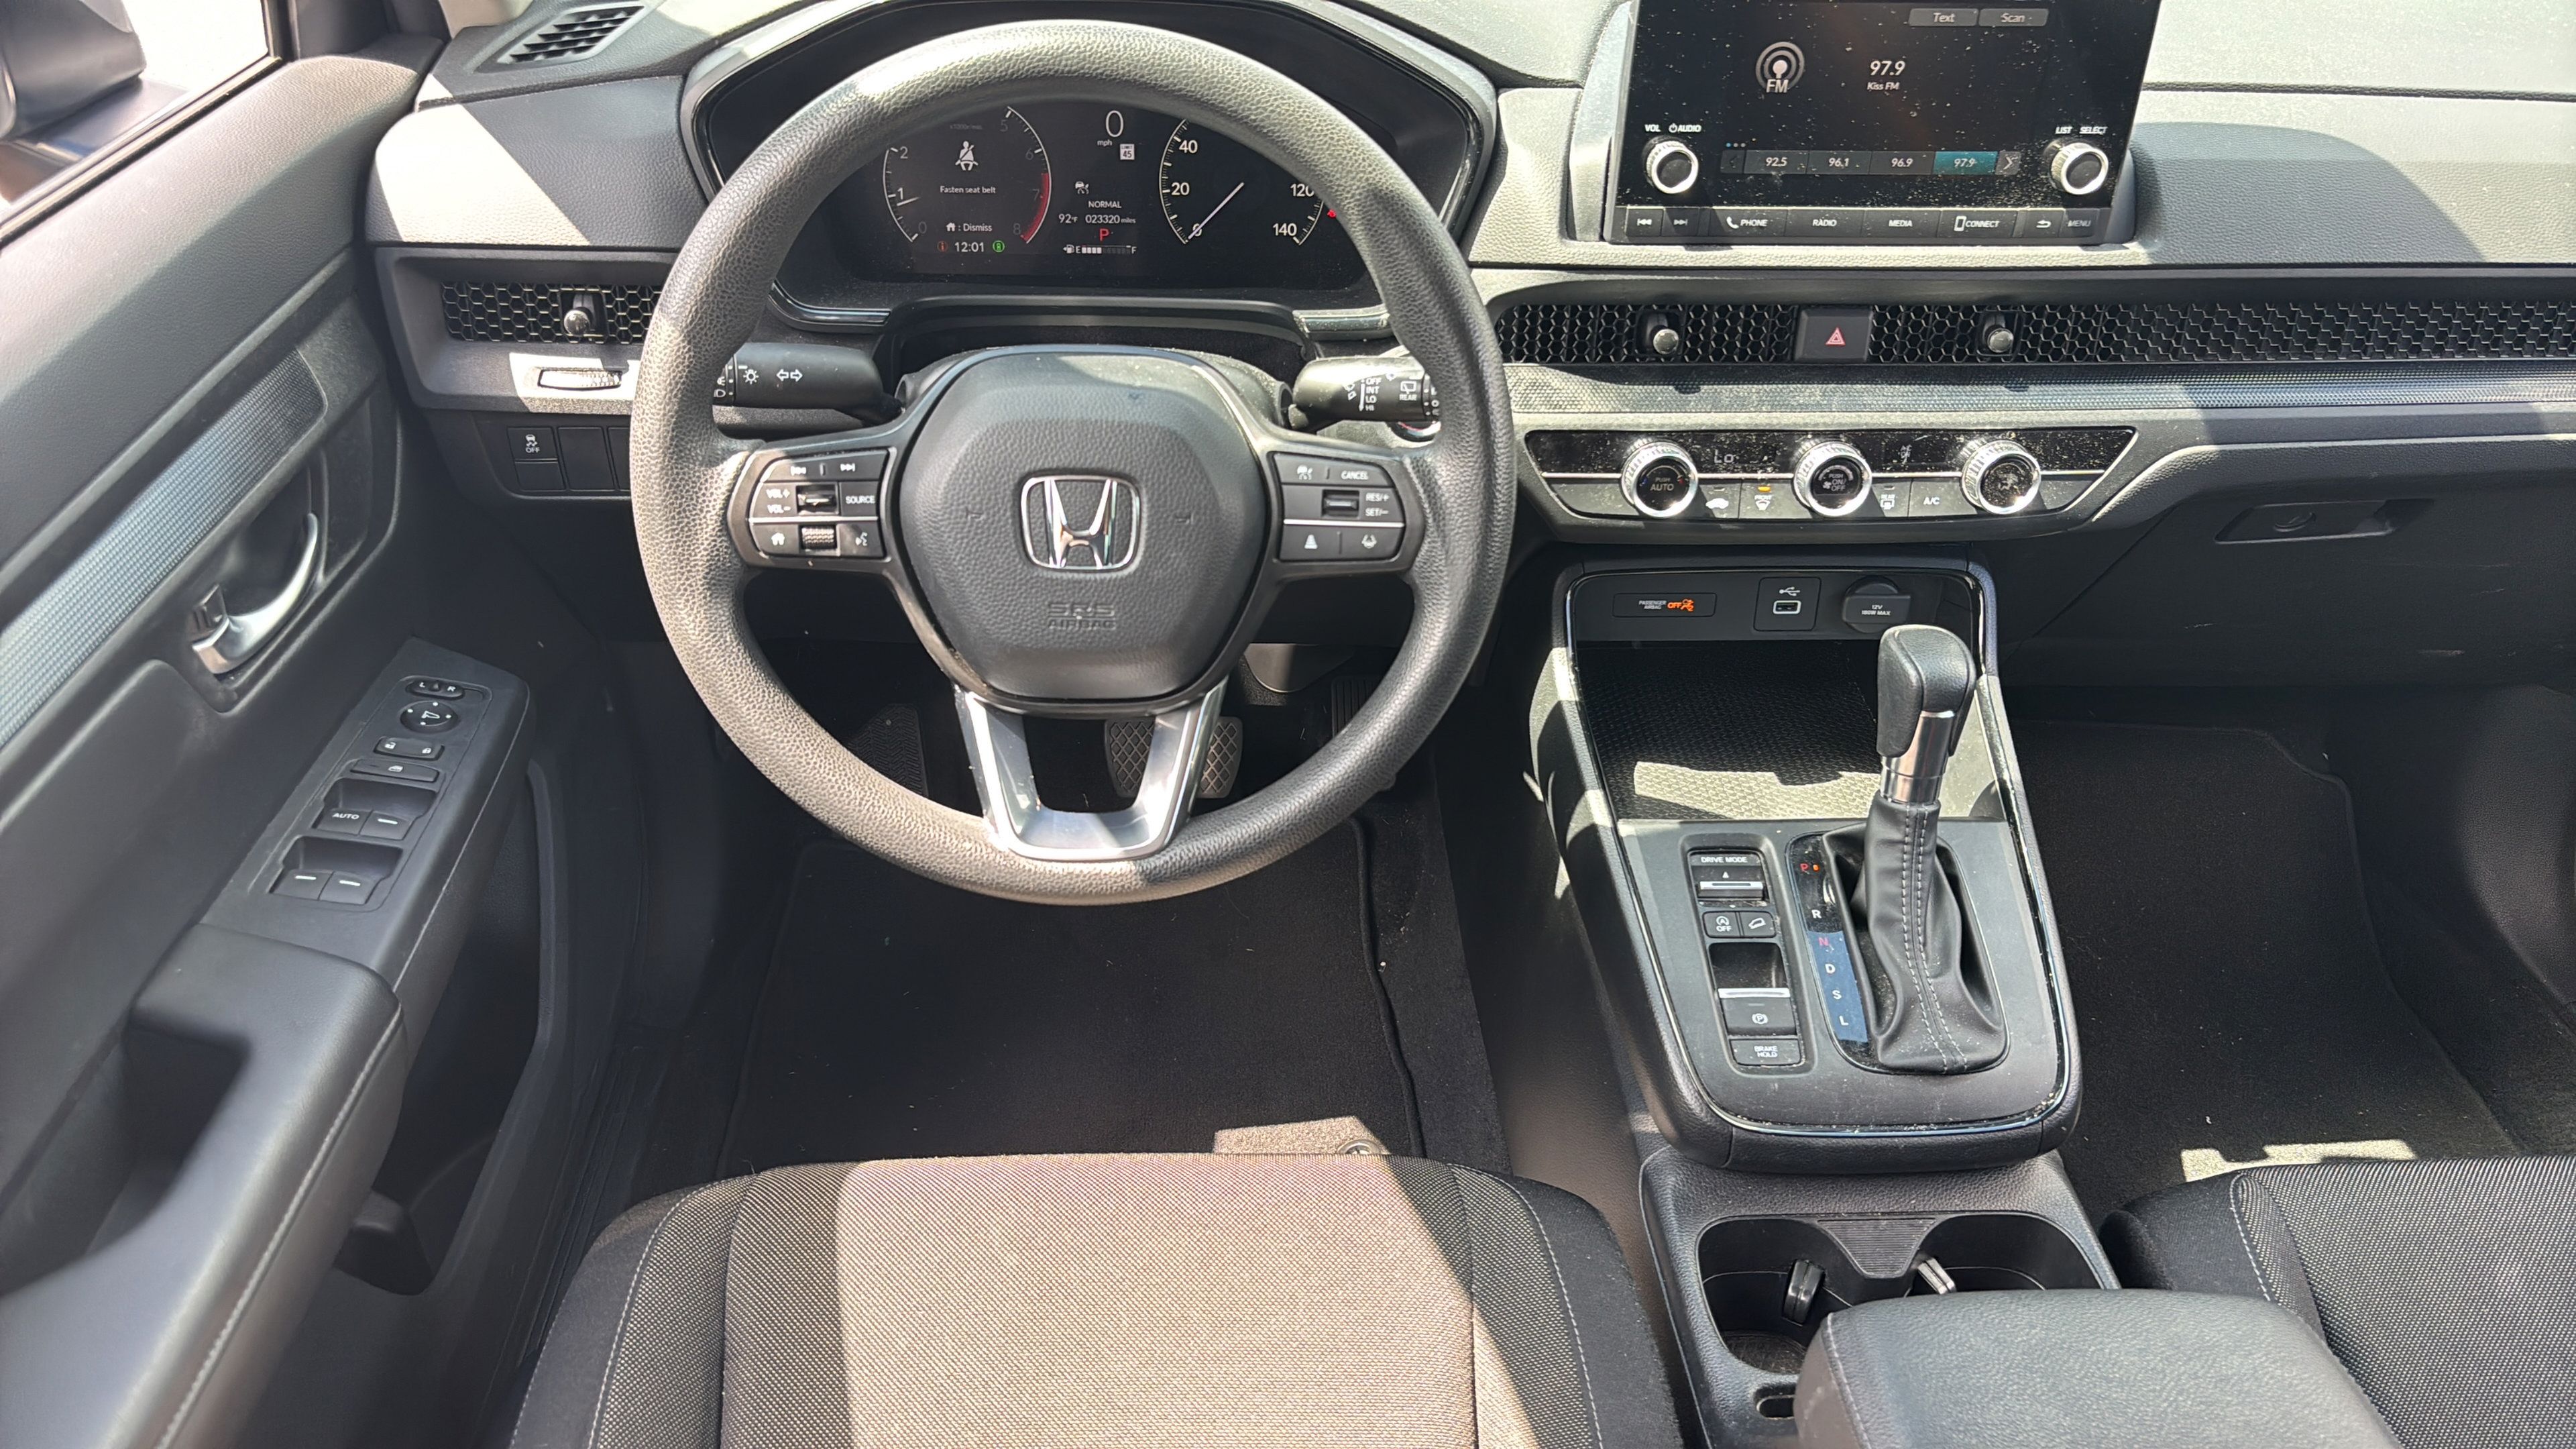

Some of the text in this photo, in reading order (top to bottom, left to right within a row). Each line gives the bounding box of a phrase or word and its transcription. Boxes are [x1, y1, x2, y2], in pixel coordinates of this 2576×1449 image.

[1934, 13, 1954, 23] Text
[2001, 13, 2025, 23] Scan
[1870, 61, 1905, 76] 97.9
[1767, 79, 1788, 93] FM
[1867, 82, 1900, 91] Kiss FM
[1001, 119, 1009, 132] 5
[1105, 110, 1124, 137] 0
[1645, 124, 1701, 133] VOL AUDIO
[2056, 126, 2072, 134] LIST
[2080, 126, 2108, 134] SELECT
[1097, 139, 1113, 148] mph
[1179, 140, 1198, 153] 40
[900, 147, 908, 159] 2
[1026, 148, 1034, 160] 6
[1123, 150, 1132, 158] 45
[1765, 157, 1787, 167] 92.5
[1828, 157, 1850, 167] 96.1
[1891, 158, 1913, 168] 96.9
[1954, 158, 1976, 168] 97.9
[897, 187, 903, 200] 1
[940, 186, 964, 194] Fasten
[982, 185, 997, 193] belt
[1172, 182, 1190, 196] 20
[1291, 184, 1314, 197] 120
[1033, 189, 1040, 201] 7
[1085, 215, 1120, 224] 023320
[1740, 219, 1767, 227] PHONE
[1813, 219, 1837, 227] RADIO
[919, 221, 927, 233] 0
[963, 223, 993, 231] Dismiss
[1013, 223, 1021, 235] 8
[1273, 223, 1297, 237] 140
[1100, 229, 1109, 240] P
[954, 241, 985, 252] 12:01
[1131, 246, 1137, 254] F
[1365, 378, 1382, 386] OFF
[1365, 386, 1380, 394] INT
[1365, 396, 1377, 404] LO
[1341, 471, 1368, 480] CANCEL
[1650, 483, 1674, 491] AUTO
[845, 495, 875, 504] SOURCE
[1923, 496, 1940, 504] A/C
[1048, 619, 1117, 631] AIRBAG
[1800, 863, 1808, 871] P
[1812, 910, 1822, 919] R
[1819, 938, 1828, 947] N
[1826, 963, 1836, 973] D
[1832, 990, 1842, 1000] S
[1840, 1016, 1849, 1026] L
